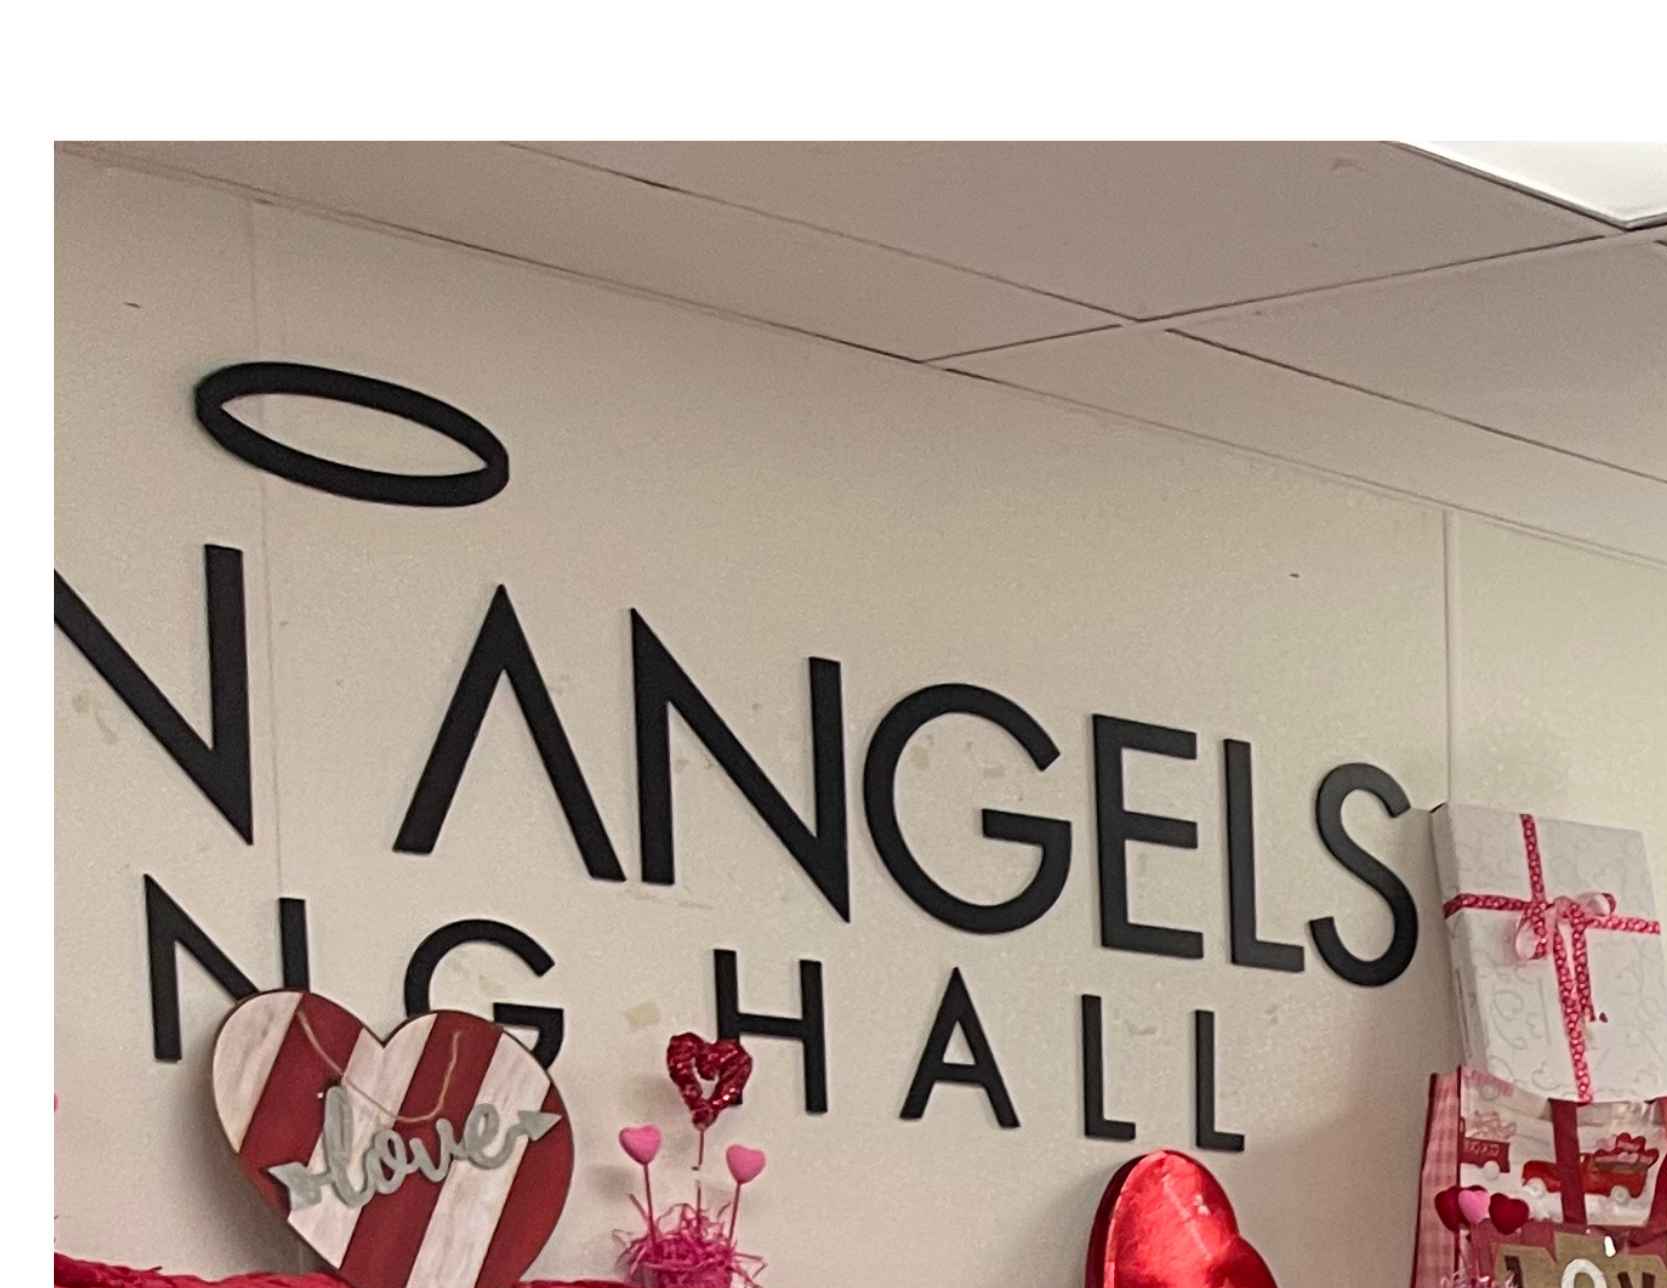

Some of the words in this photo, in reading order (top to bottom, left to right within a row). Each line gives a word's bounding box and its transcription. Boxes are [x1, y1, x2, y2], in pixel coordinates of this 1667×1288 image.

[392, 584, 1421, 988] ANGELS
[324, 1085, 515, 1209] love
[713, 948, 1246, 1152] HALL
